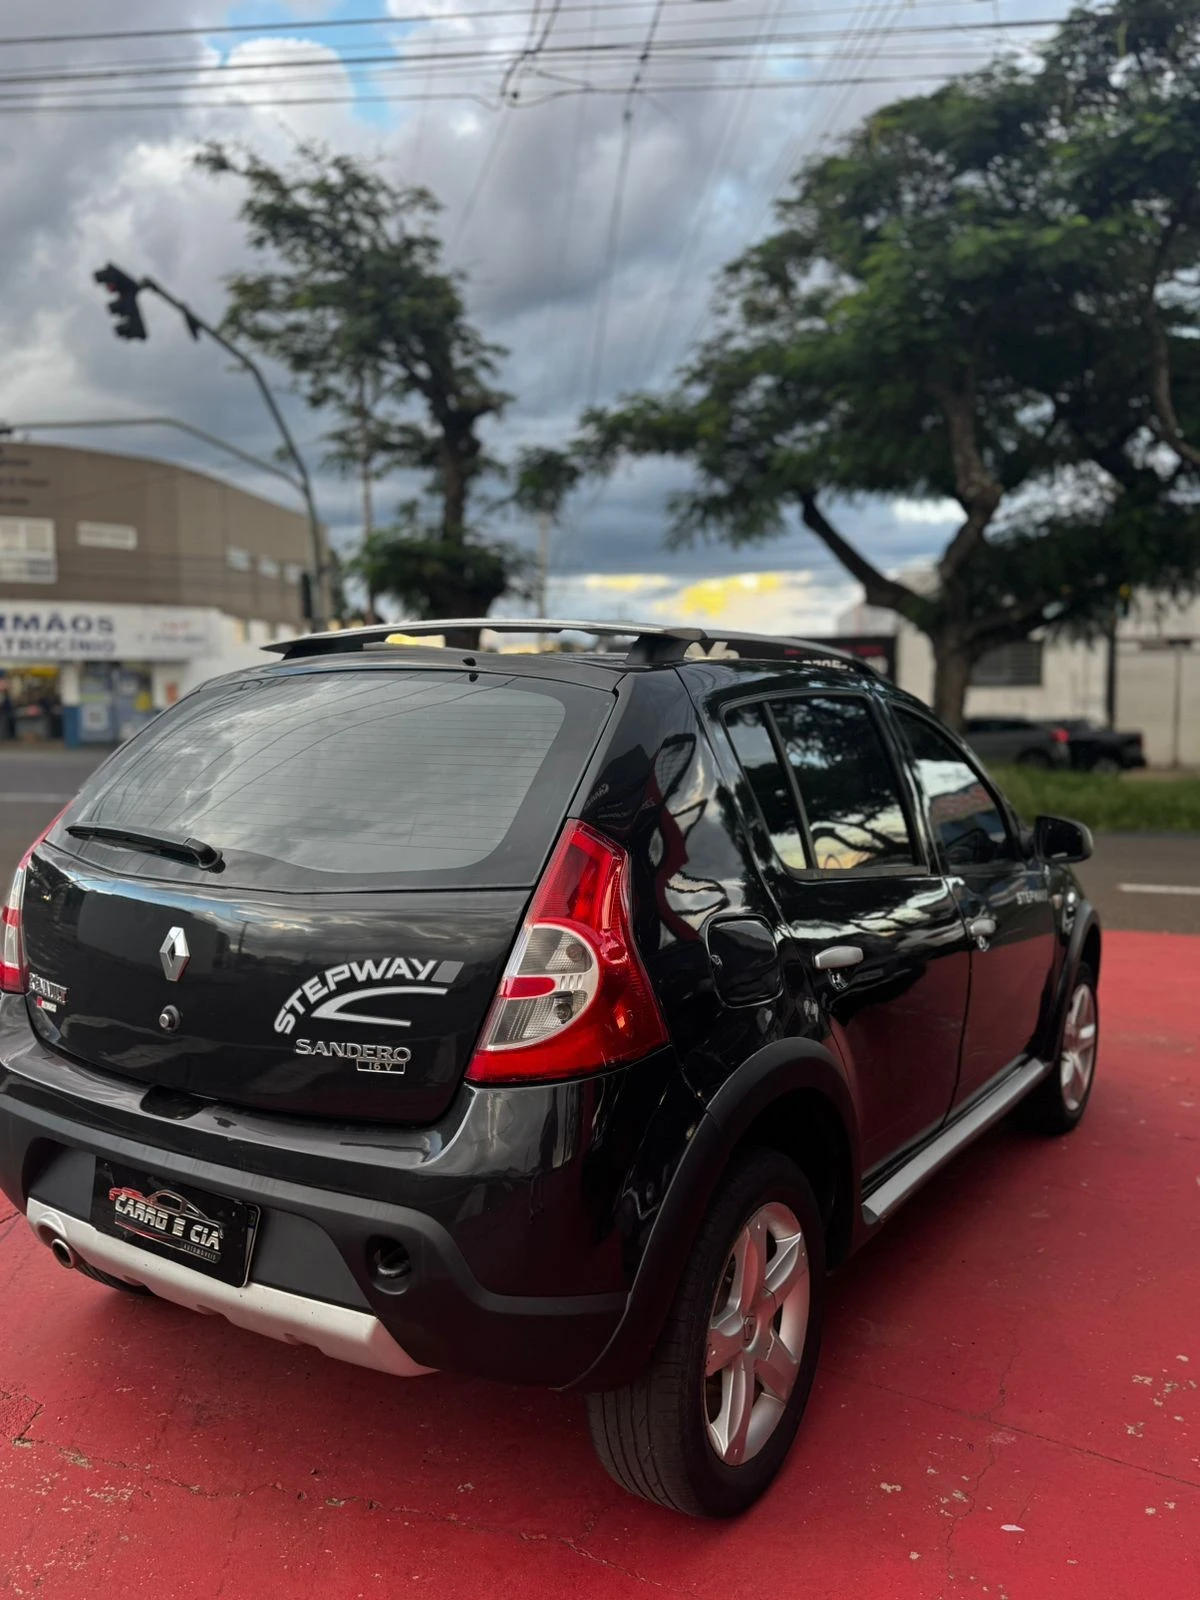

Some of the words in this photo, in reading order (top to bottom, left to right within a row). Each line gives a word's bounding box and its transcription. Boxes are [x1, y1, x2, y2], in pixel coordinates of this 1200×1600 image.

[0, 610, 114, 632] MÃOS
[273, 957, 437, 1035] STEPWAY
[295, 1038, 412, 1063] SANDERO
[115, 1194, 168, 1231] CARRO
[171, 1217, 186, 1237] E
